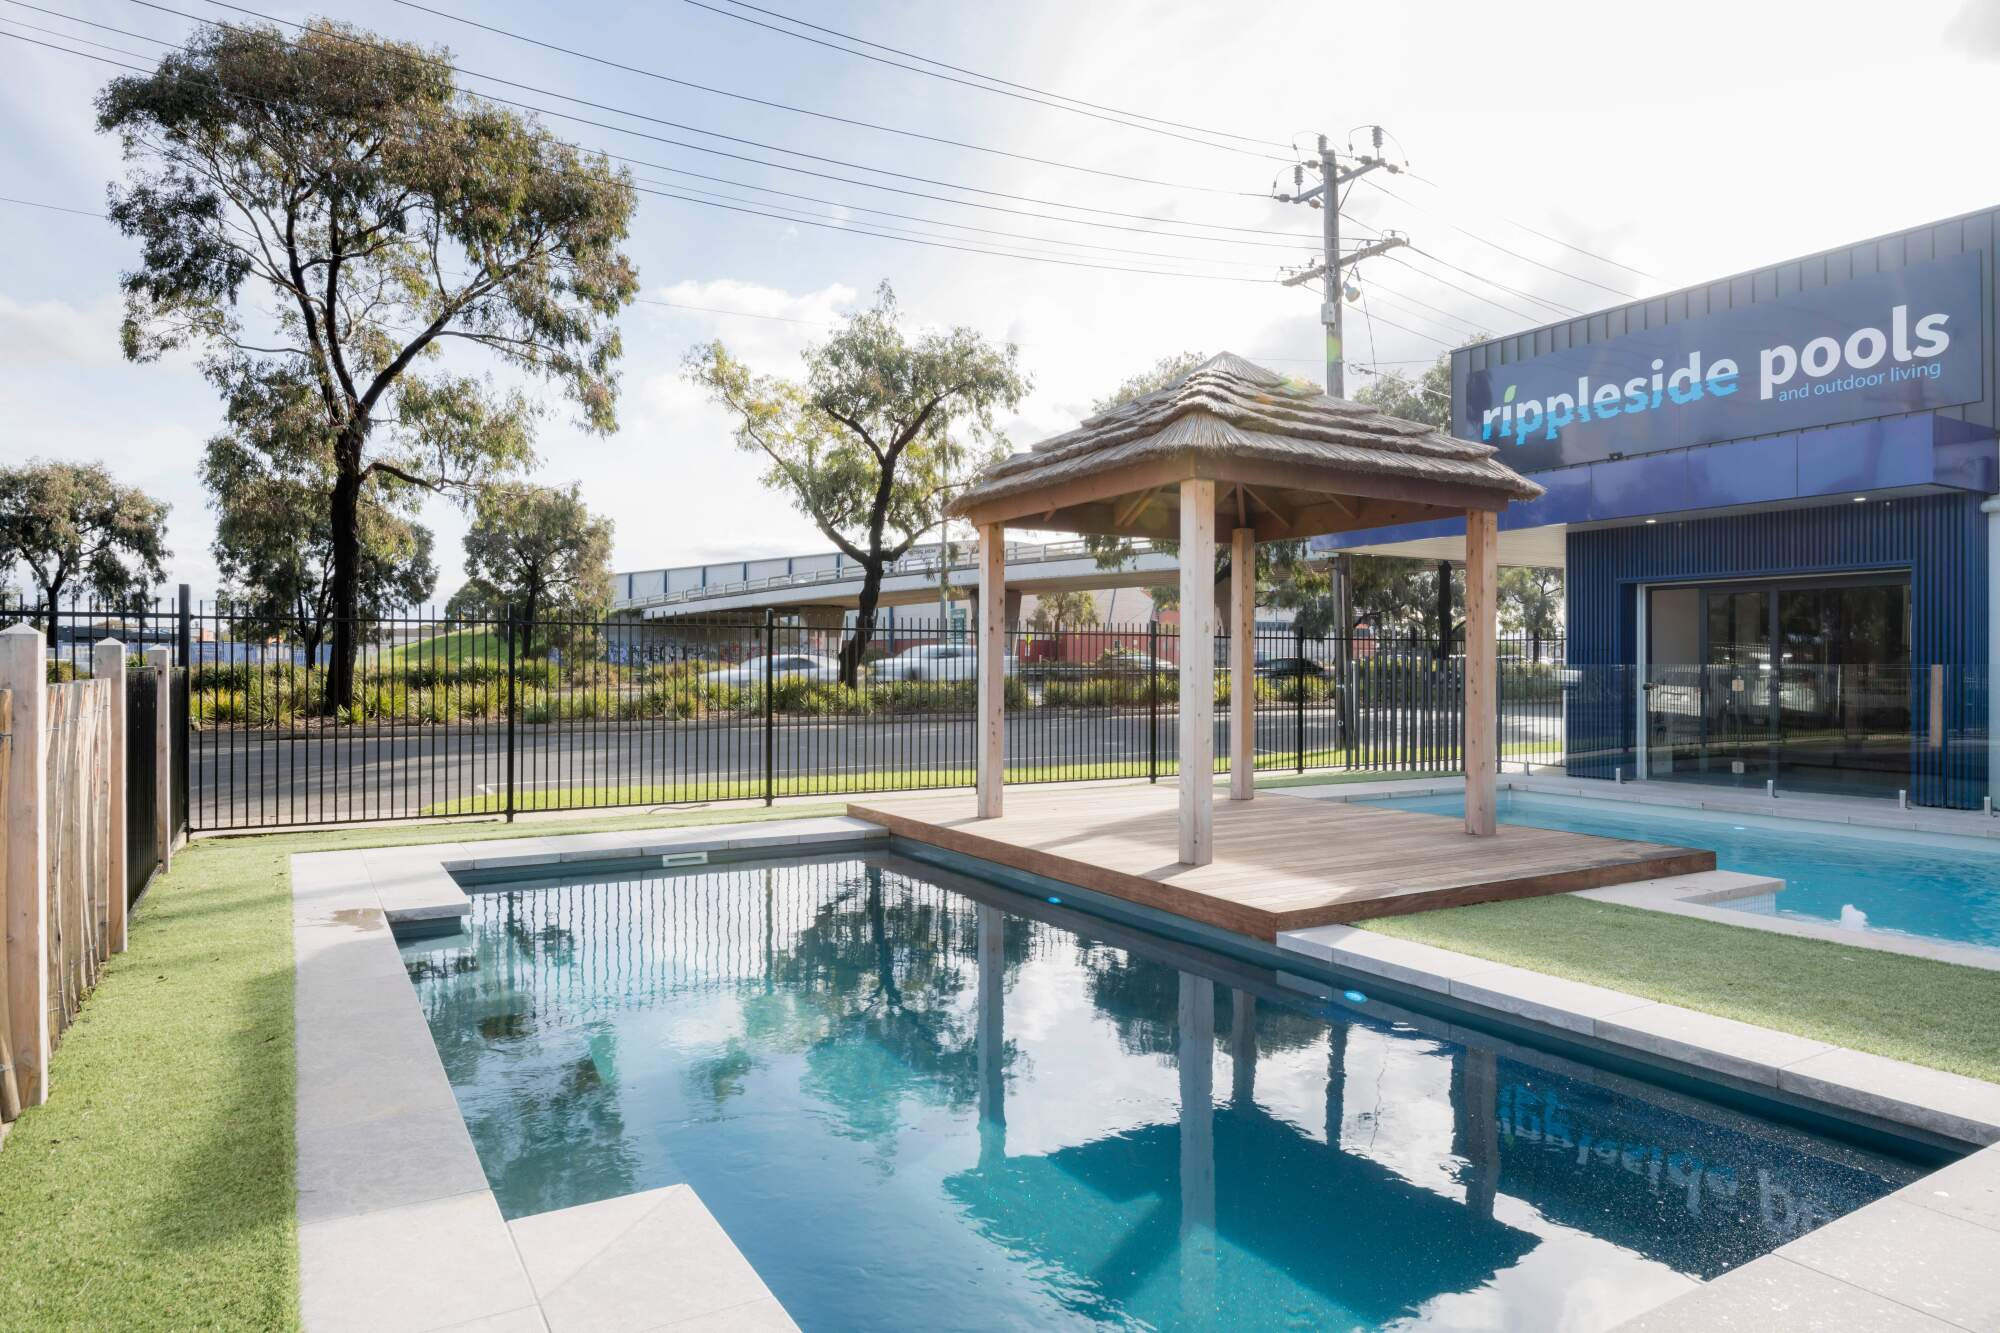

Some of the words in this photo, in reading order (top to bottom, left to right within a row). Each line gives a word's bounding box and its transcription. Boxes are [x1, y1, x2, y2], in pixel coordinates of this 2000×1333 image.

[1482, 351, 1739, 446] rippleside
[1760, 304, 1950, 400] pools
[1778, 384, 1809, 401] and
[1814, 372, 1886, 396] outdoor
[1890, 362, 1942, 382] living
